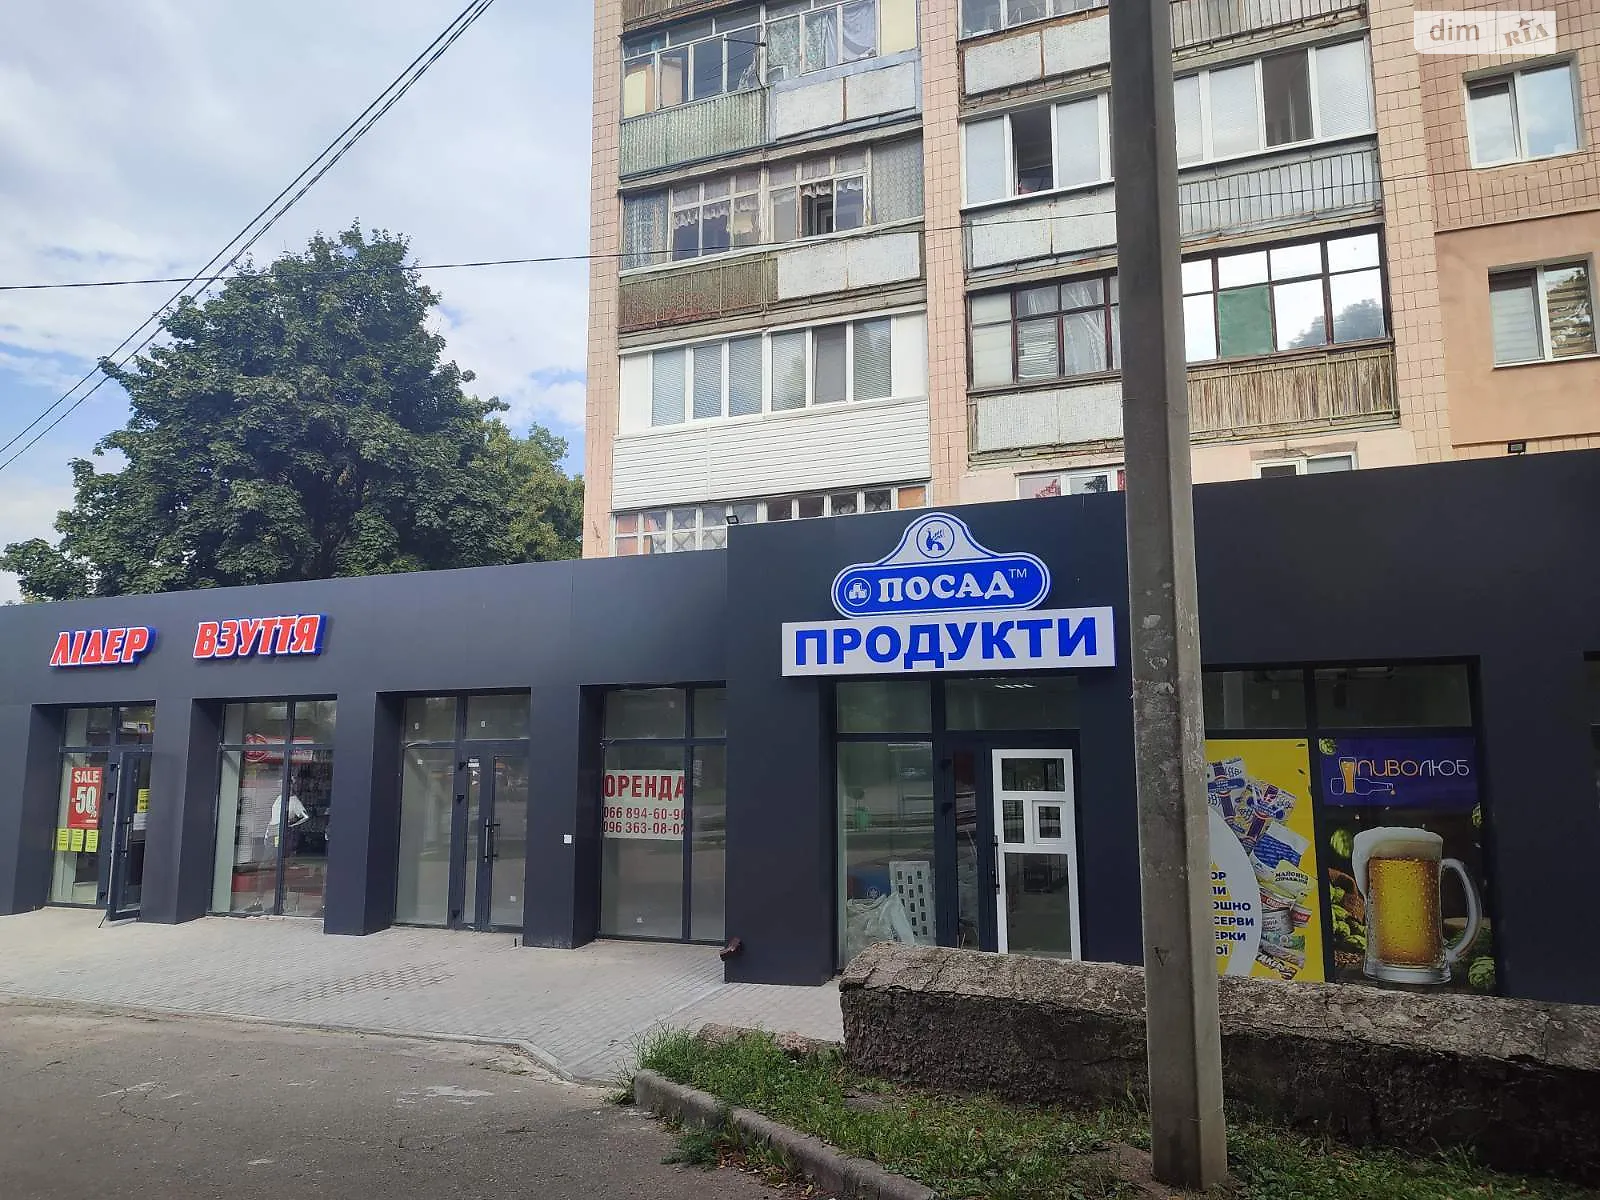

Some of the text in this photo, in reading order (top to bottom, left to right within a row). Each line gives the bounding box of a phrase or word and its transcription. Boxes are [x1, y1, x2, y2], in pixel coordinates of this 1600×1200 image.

[877, 570, 1015, 603] ПОСАД
[49, 614, 326, 668] ЛІДЕР ВЗУТТЯ
[795, 616, 1097, 669] ПРОДУКТИ
[74, 770, 99, 784] SALE
[1357, 759, 1470, 777] ПИВОЛЮБ
[604, 775, 685, 801] ОРЕНДА
[603, 807, 623, 819] 066
[603, 821, 622, 833] 096
